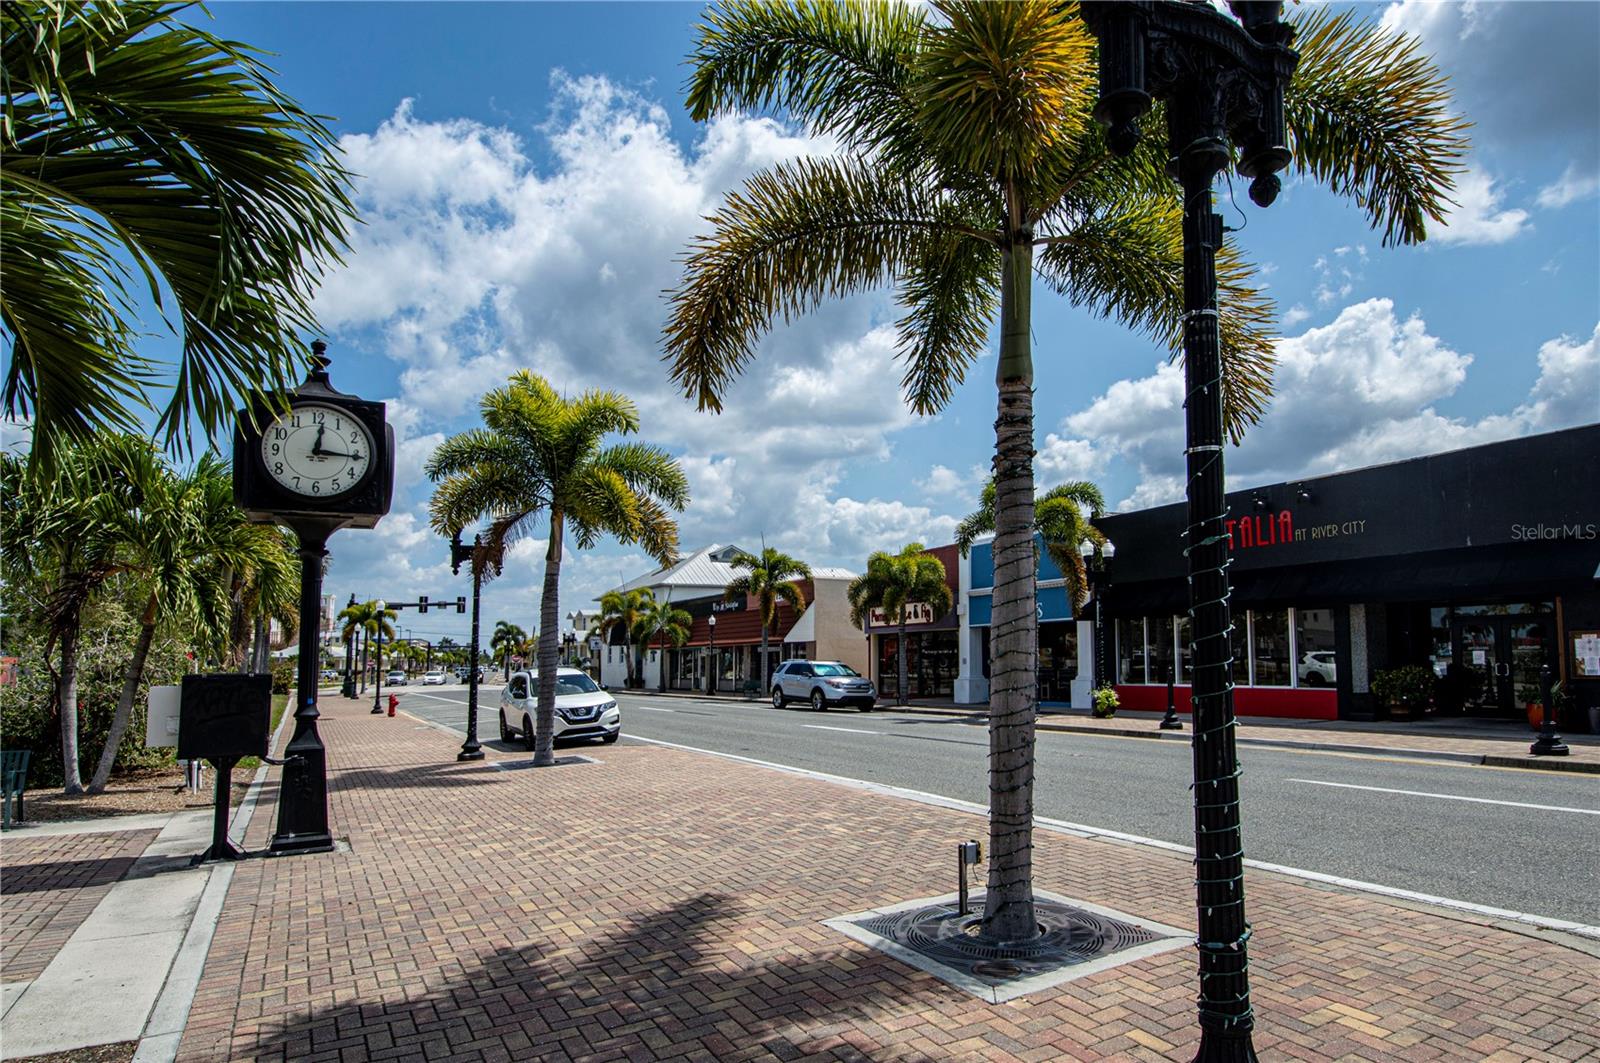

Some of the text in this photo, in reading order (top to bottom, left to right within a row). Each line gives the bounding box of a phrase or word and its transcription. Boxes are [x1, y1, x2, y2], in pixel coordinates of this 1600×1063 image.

[291, 416, 301, 428] 11
[312, 412, 325, 424] 12
[335, 418, 341, 430] 1
[274, 427, 287, 440] 10
[351, 431, 358, 444] 2
[271, 443, 280, 456] 9
[274, 462, 284, 475] 8
[347, 466, 356, 479] 4
[291, 476, 302, 489] 7
[312, 480, 320, 493] 6
[331, 478, 341, 490] 5
[1224, 508, 1366, 551] TALIA AT RIVER CITY
